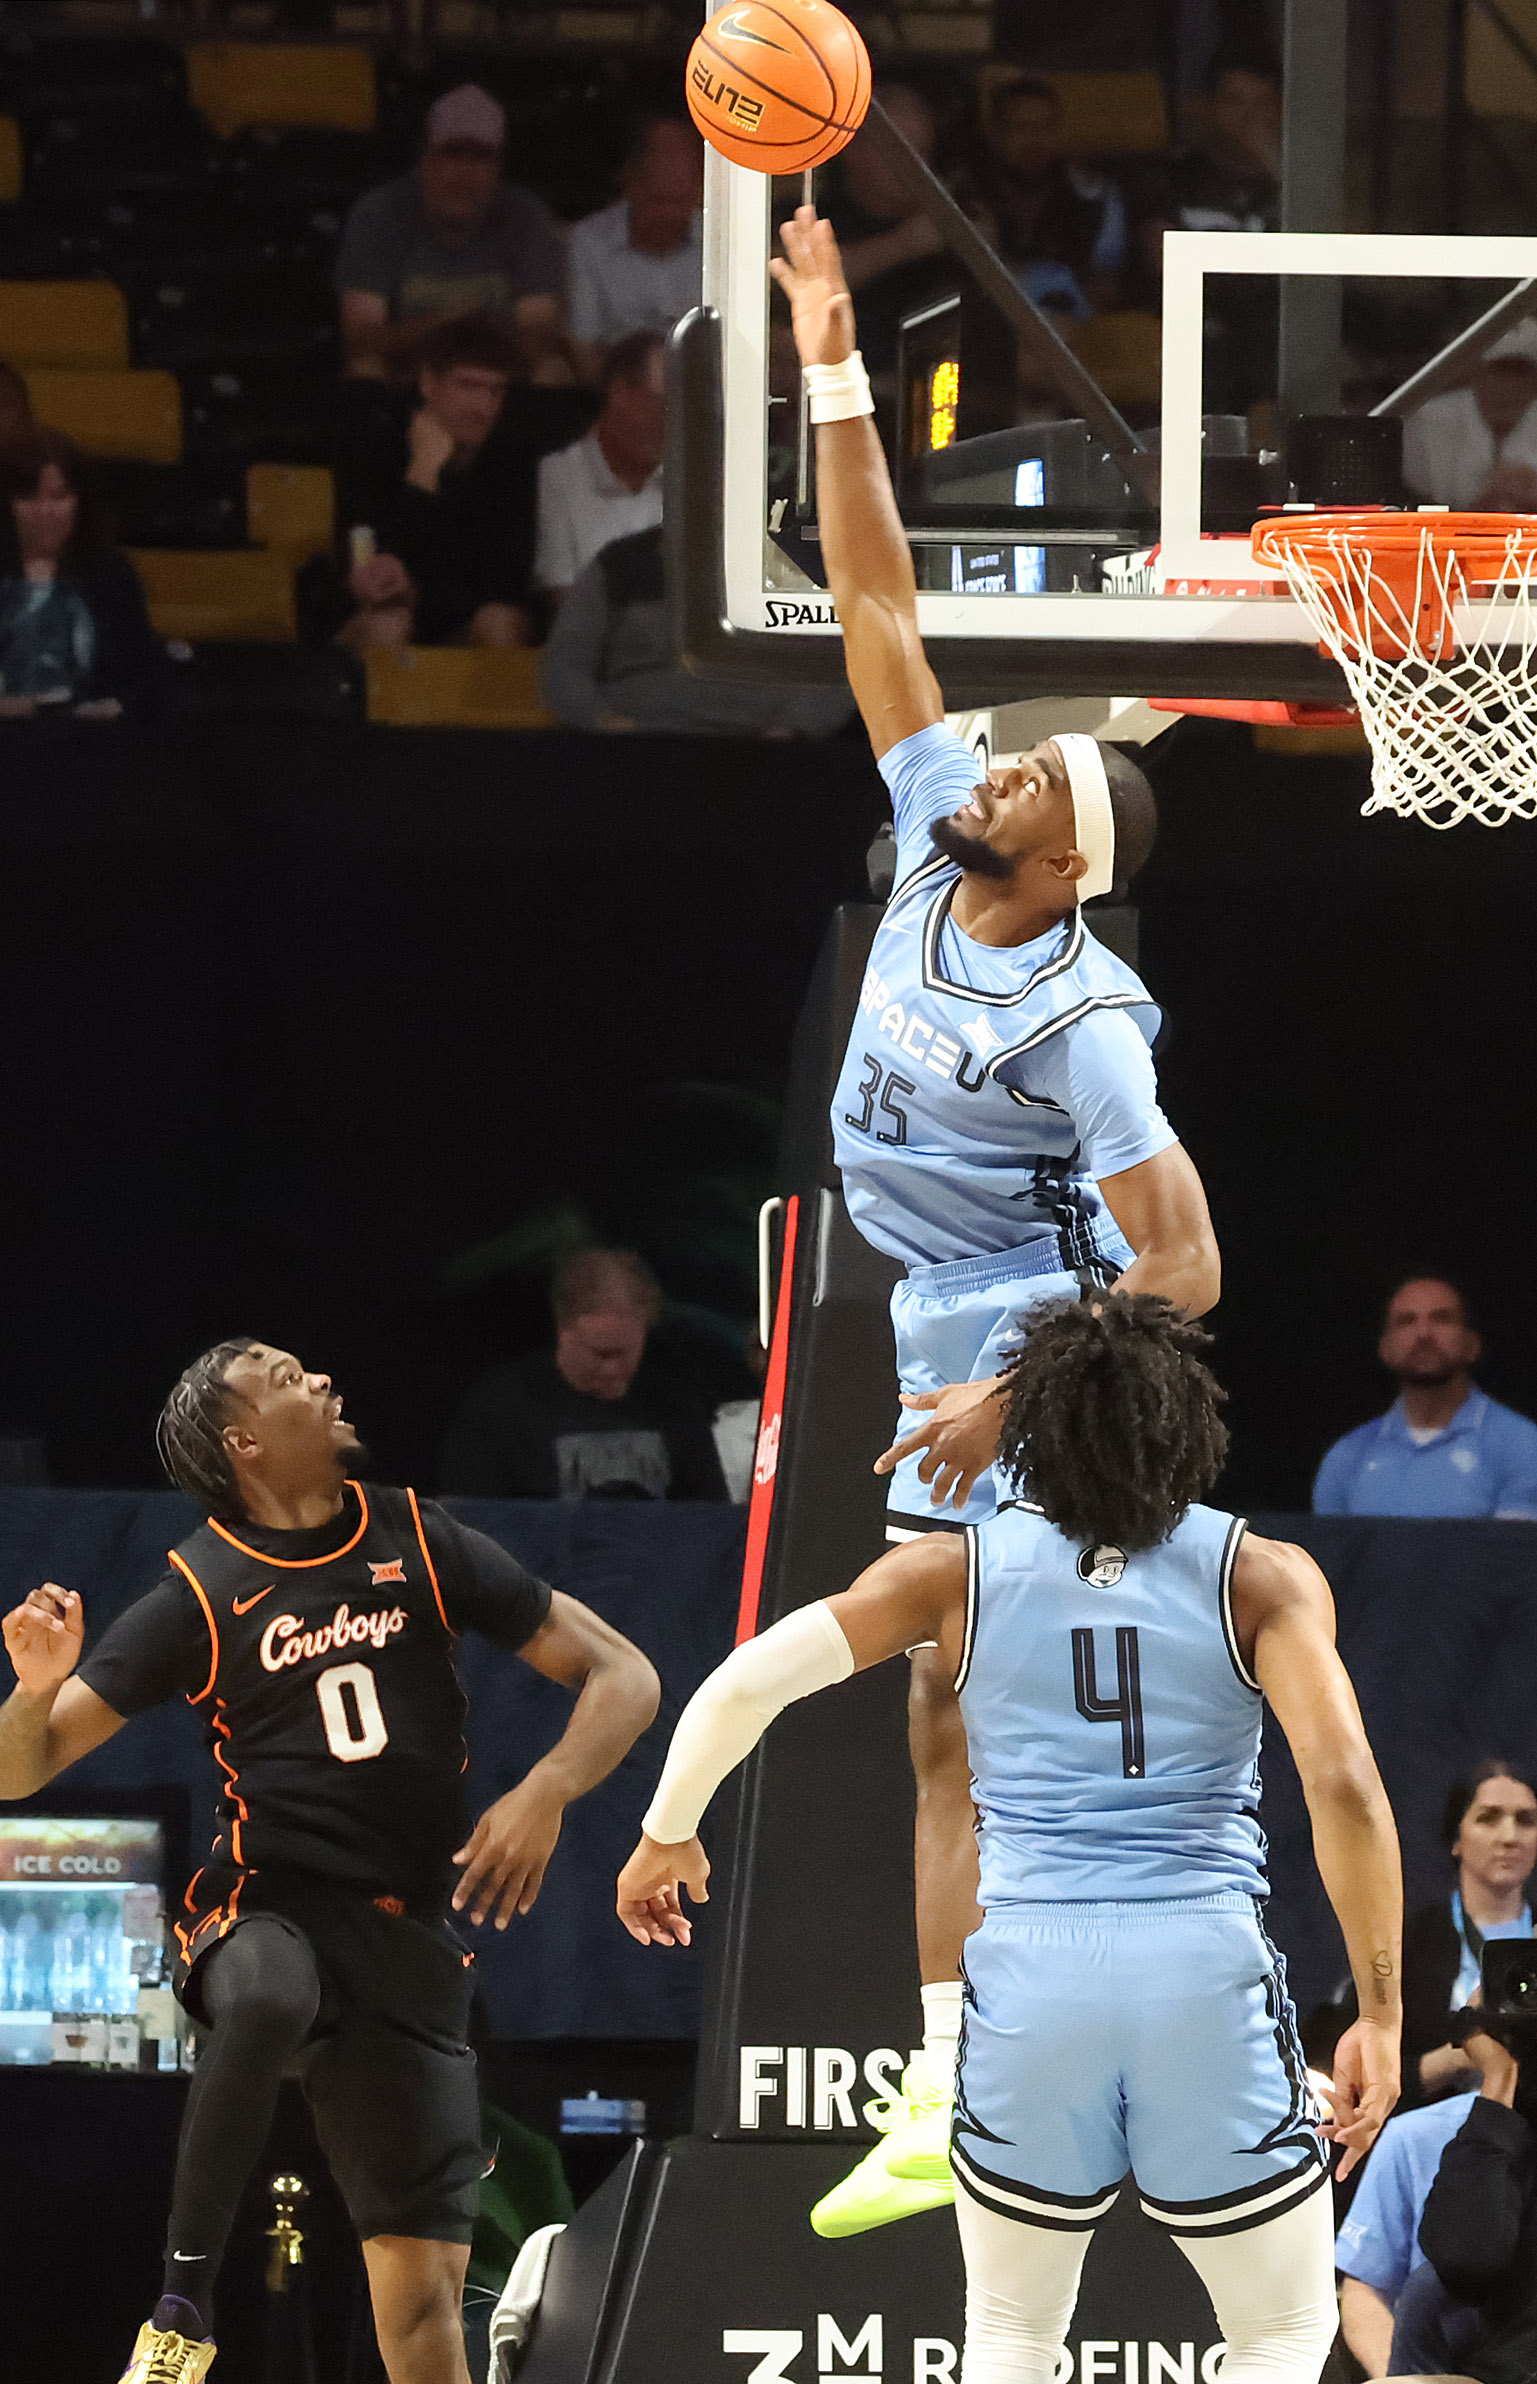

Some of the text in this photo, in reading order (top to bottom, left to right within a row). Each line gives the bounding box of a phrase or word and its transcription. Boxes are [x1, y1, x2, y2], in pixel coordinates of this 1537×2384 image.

[692, 59, 765, 126] ELITE
[845, 1052, 916, 1146] 35
[260, 1603, 409, 1672] Cowboys
[315, 1661, 389, 1764] 0
[1071, 1626, 1146, 1779] 4
[14, 1855, 122, 1875] ICE COLD
[738, 2046, 927, 2131] FIRS
